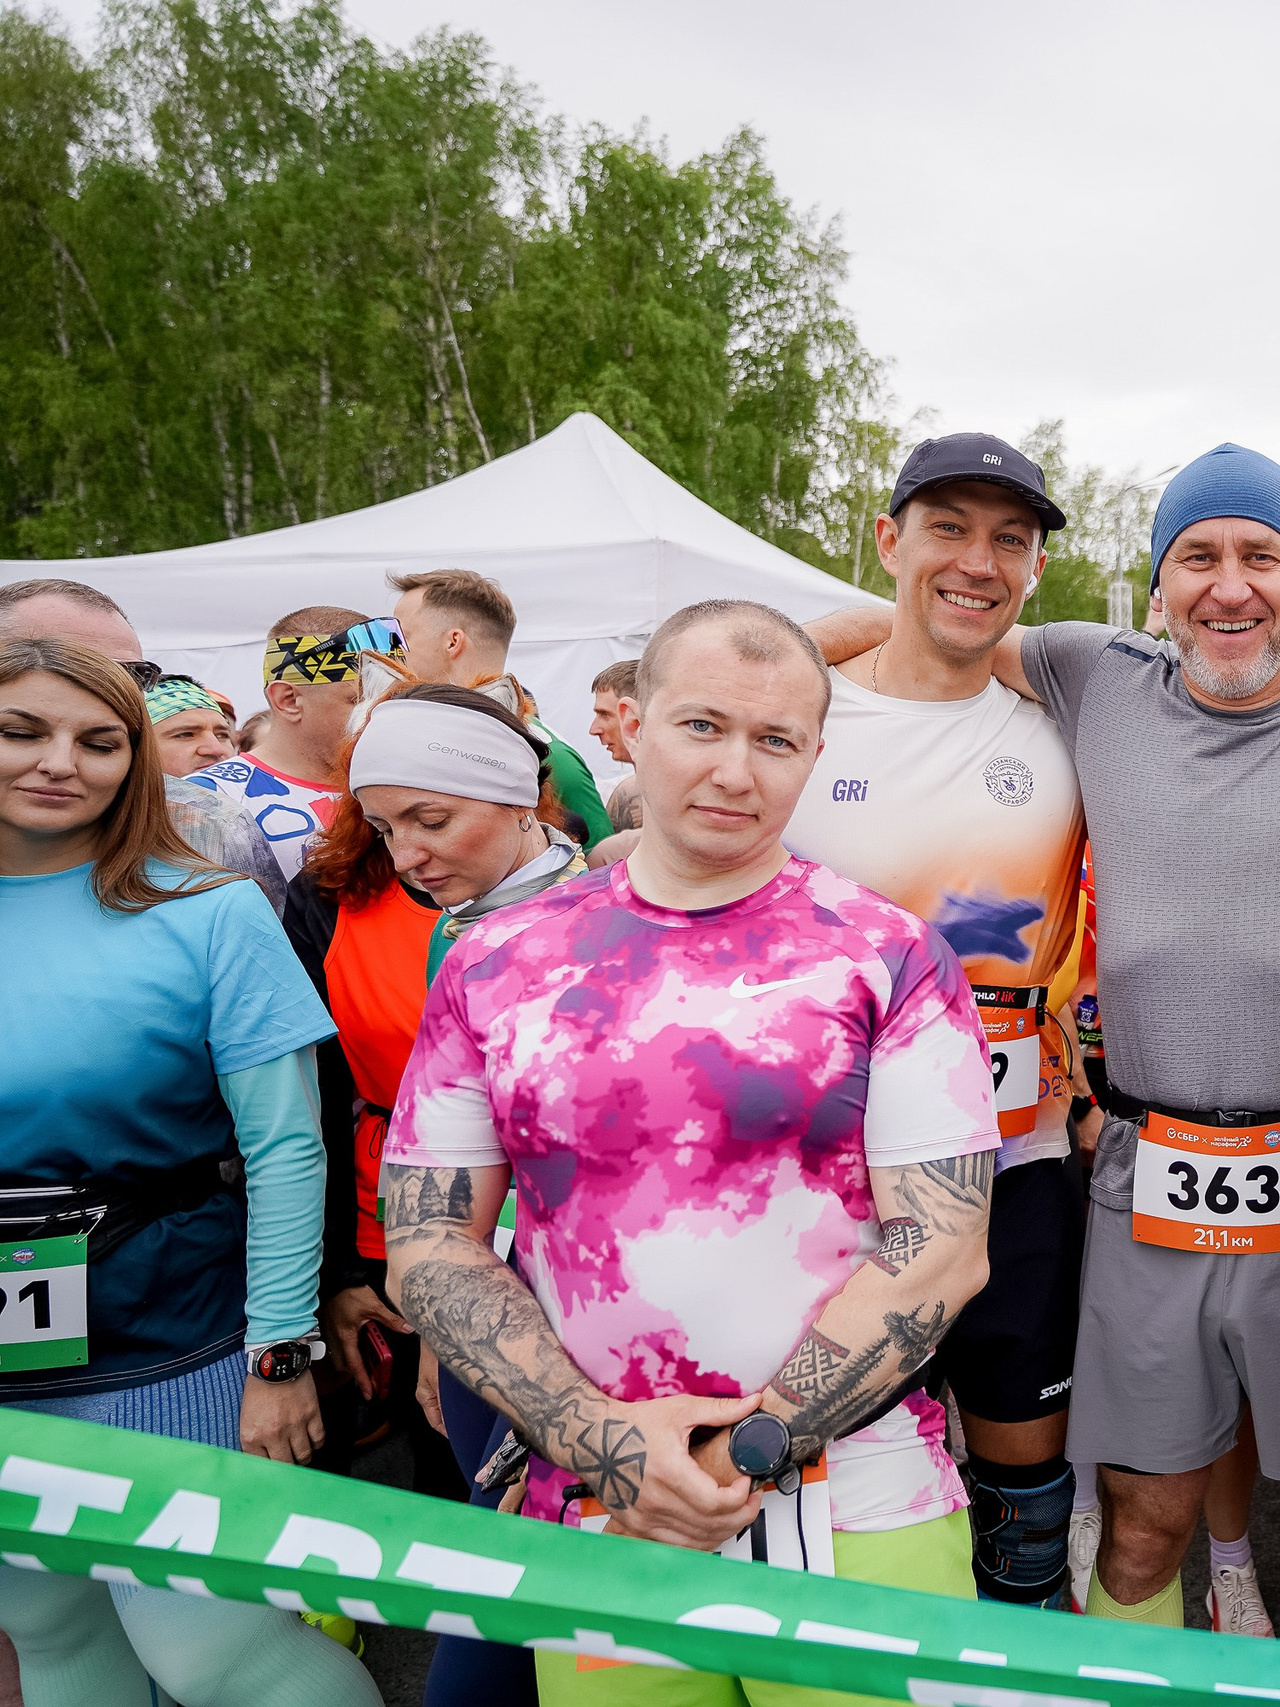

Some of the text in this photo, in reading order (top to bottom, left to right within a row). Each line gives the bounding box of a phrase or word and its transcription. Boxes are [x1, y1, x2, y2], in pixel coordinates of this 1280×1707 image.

[982, 453, 1003, 466] GRi
[427, 741, 507, 770] Genwarsen
[832, 779, 869, 802] GRi
[1177, 1131, 1200, 1143] СБЕР
[1167, 1161, 1280, 1214] 363
[1194, 1228, 1228, 1249] 21,1
